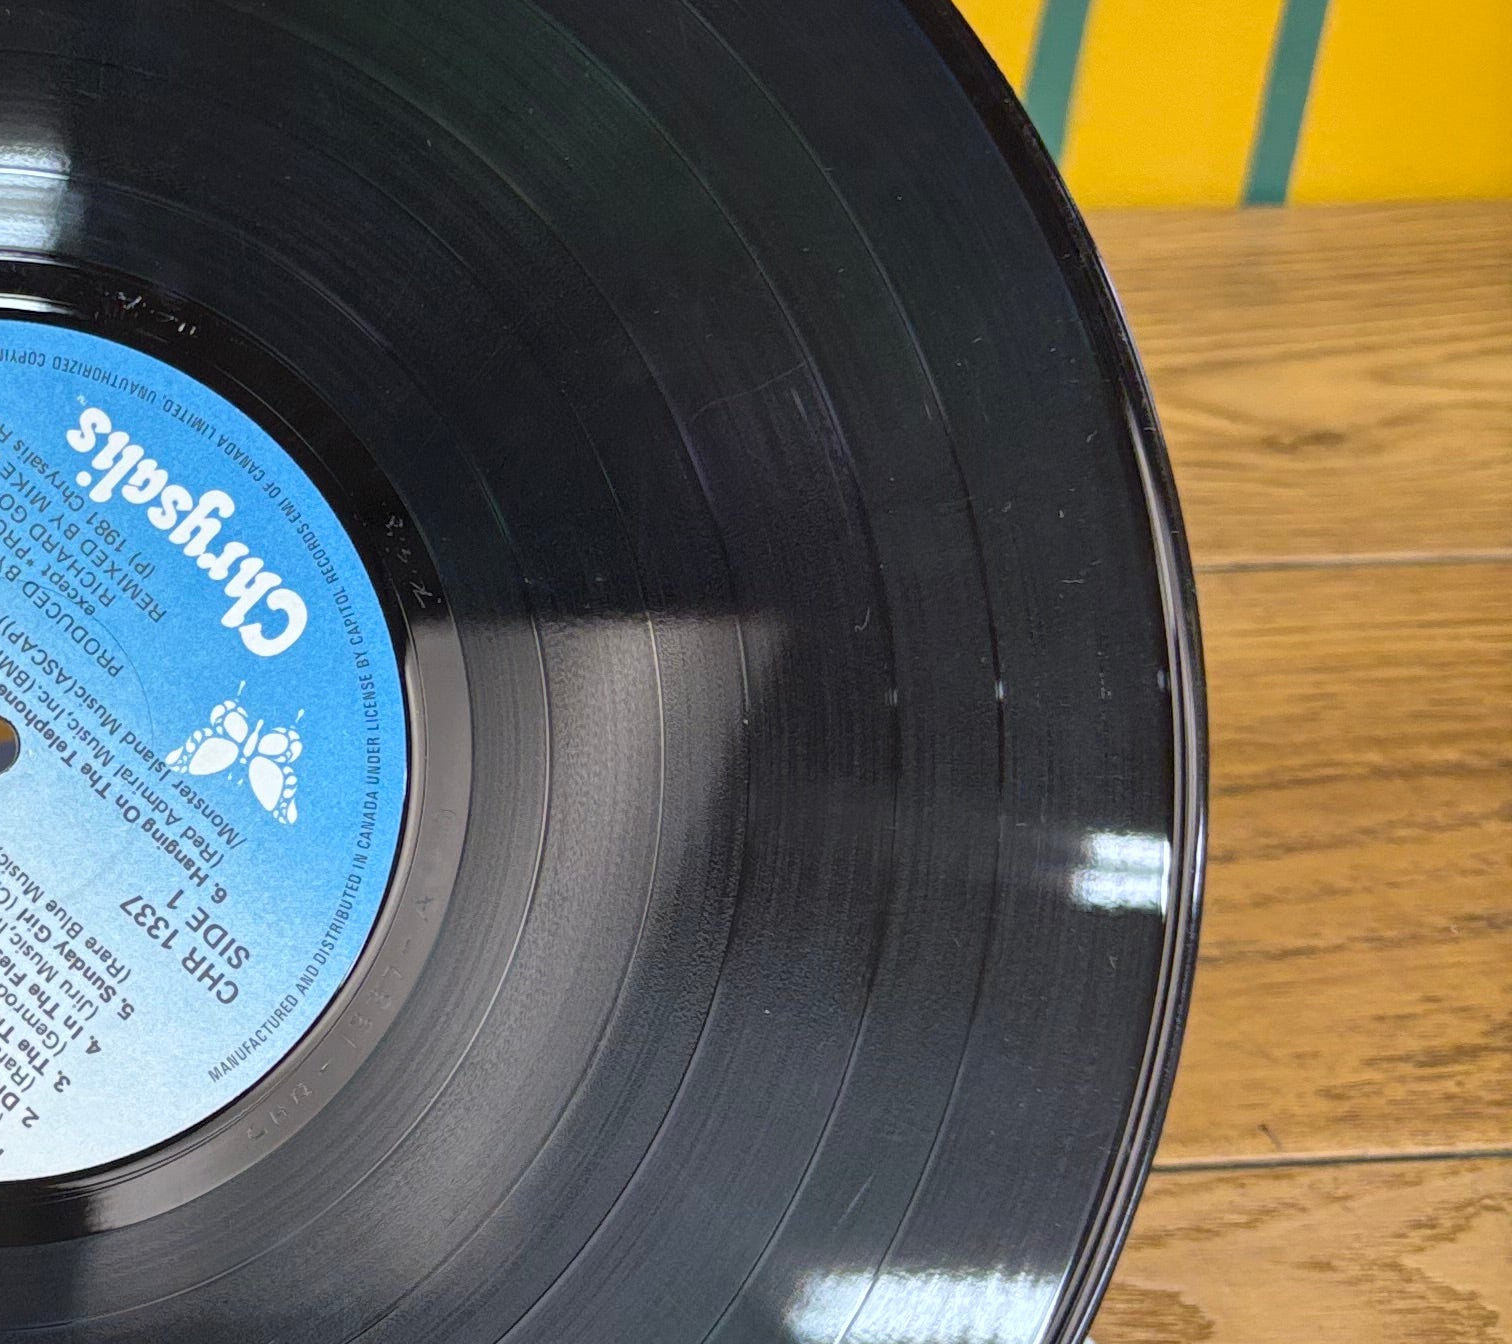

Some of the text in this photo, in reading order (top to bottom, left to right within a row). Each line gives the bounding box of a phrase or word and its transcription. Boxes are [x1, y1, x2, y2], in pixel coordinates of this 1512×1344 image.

[51, 355, 156, 404] UNAUTHORIZED
[12, 439, 84, 511] Chrysalis
[216, 434, 265, 481] CANADA
[262, 481, 281, 498] OF
[47, 513, 80, 540] BY
[66, 407, 307, 656] Chrysalis
[85, 511, 126, 552] 1981
[28, 523, 116, 607] RICHARD
[79, 538, 167, 622] REMIXED
[128, 551, 155, 580] (P)
[40, 563, 95, 615] except
[21, 580, 124, 677] PRODUCED
[332, 586, 363, 645] CAPITOL
[353, 651, 370, 668] BY
[358, 673, 379, 730] LICENSE
[118, 730, 171, 781] Island
[365, 736, 381, 784] UNDER
[80, 762, 111, 799] The
[112, 763, 182, 825] Admiral
[115, 794, 140, 823] On
[171, 779, 247, 849] /Monster
[356, 791, 378, 849] CANADA
[140, 817, 209, 887] Hanging
[179, 825, 224, 869] (Red
[351, 853, 367, 869] IN
[210, 882, 227, 904] 6.
[15, 907, 51, 943] Girl
[45, 899, 83, 939] Blue
[166, 888, 250, 969] SIDE 1
[312, 873, 361, 965] DISTRIBUTED
[52, 940, 116, 1003] Sunday
[84, 936, 131, 984] (Rare
[119, 895, 238, 1004] CHR 1337
[27, 983, 59, 1020] The
[59, 979, 98, 1021] (Jiru
[295, 964, 319, 996] AND
[63, 1014, 83, 1040] In
[116, 997, 134, 1020] 5.
[17, 1038, 49, 1076] The
[85, 1035, 101, 1054] 4.
[207, 994, 298, 1082] MANUFACTURED
[53, 1070, 70, 1093] 3.
